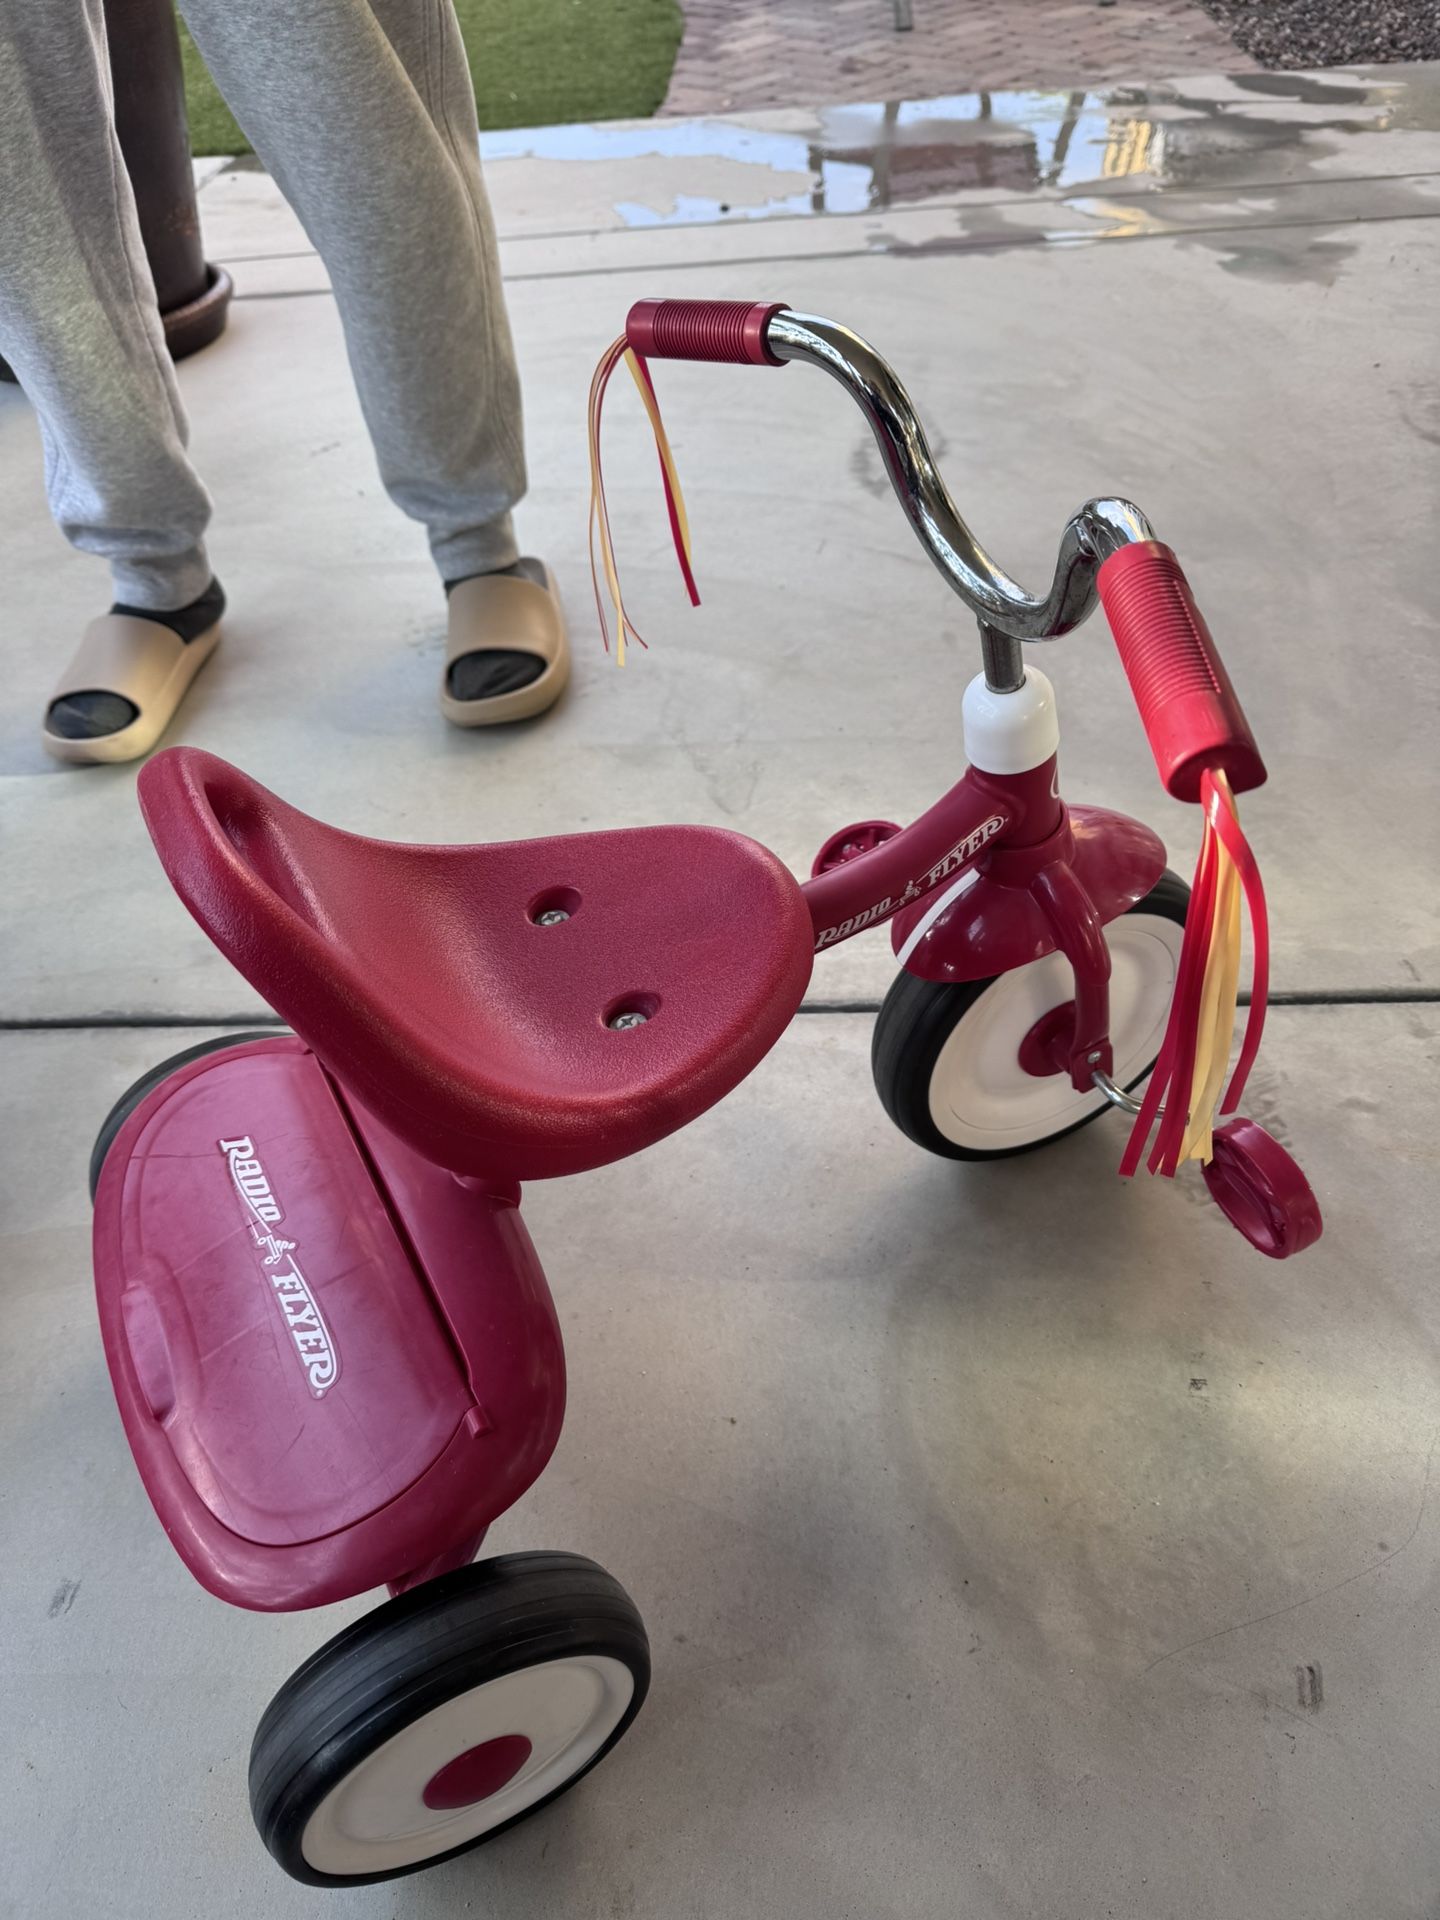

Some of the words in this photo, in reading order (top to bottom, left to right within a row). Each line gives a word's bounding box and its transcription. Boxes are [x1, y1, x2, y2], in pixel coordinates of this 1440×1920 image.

[815, 896, 892, 948] RADIO
[927, 816, 1004, 887] FLYER
[219, 1135, 281, 1232] RADIO
[271, 1271, 337, 1388] FLYER
